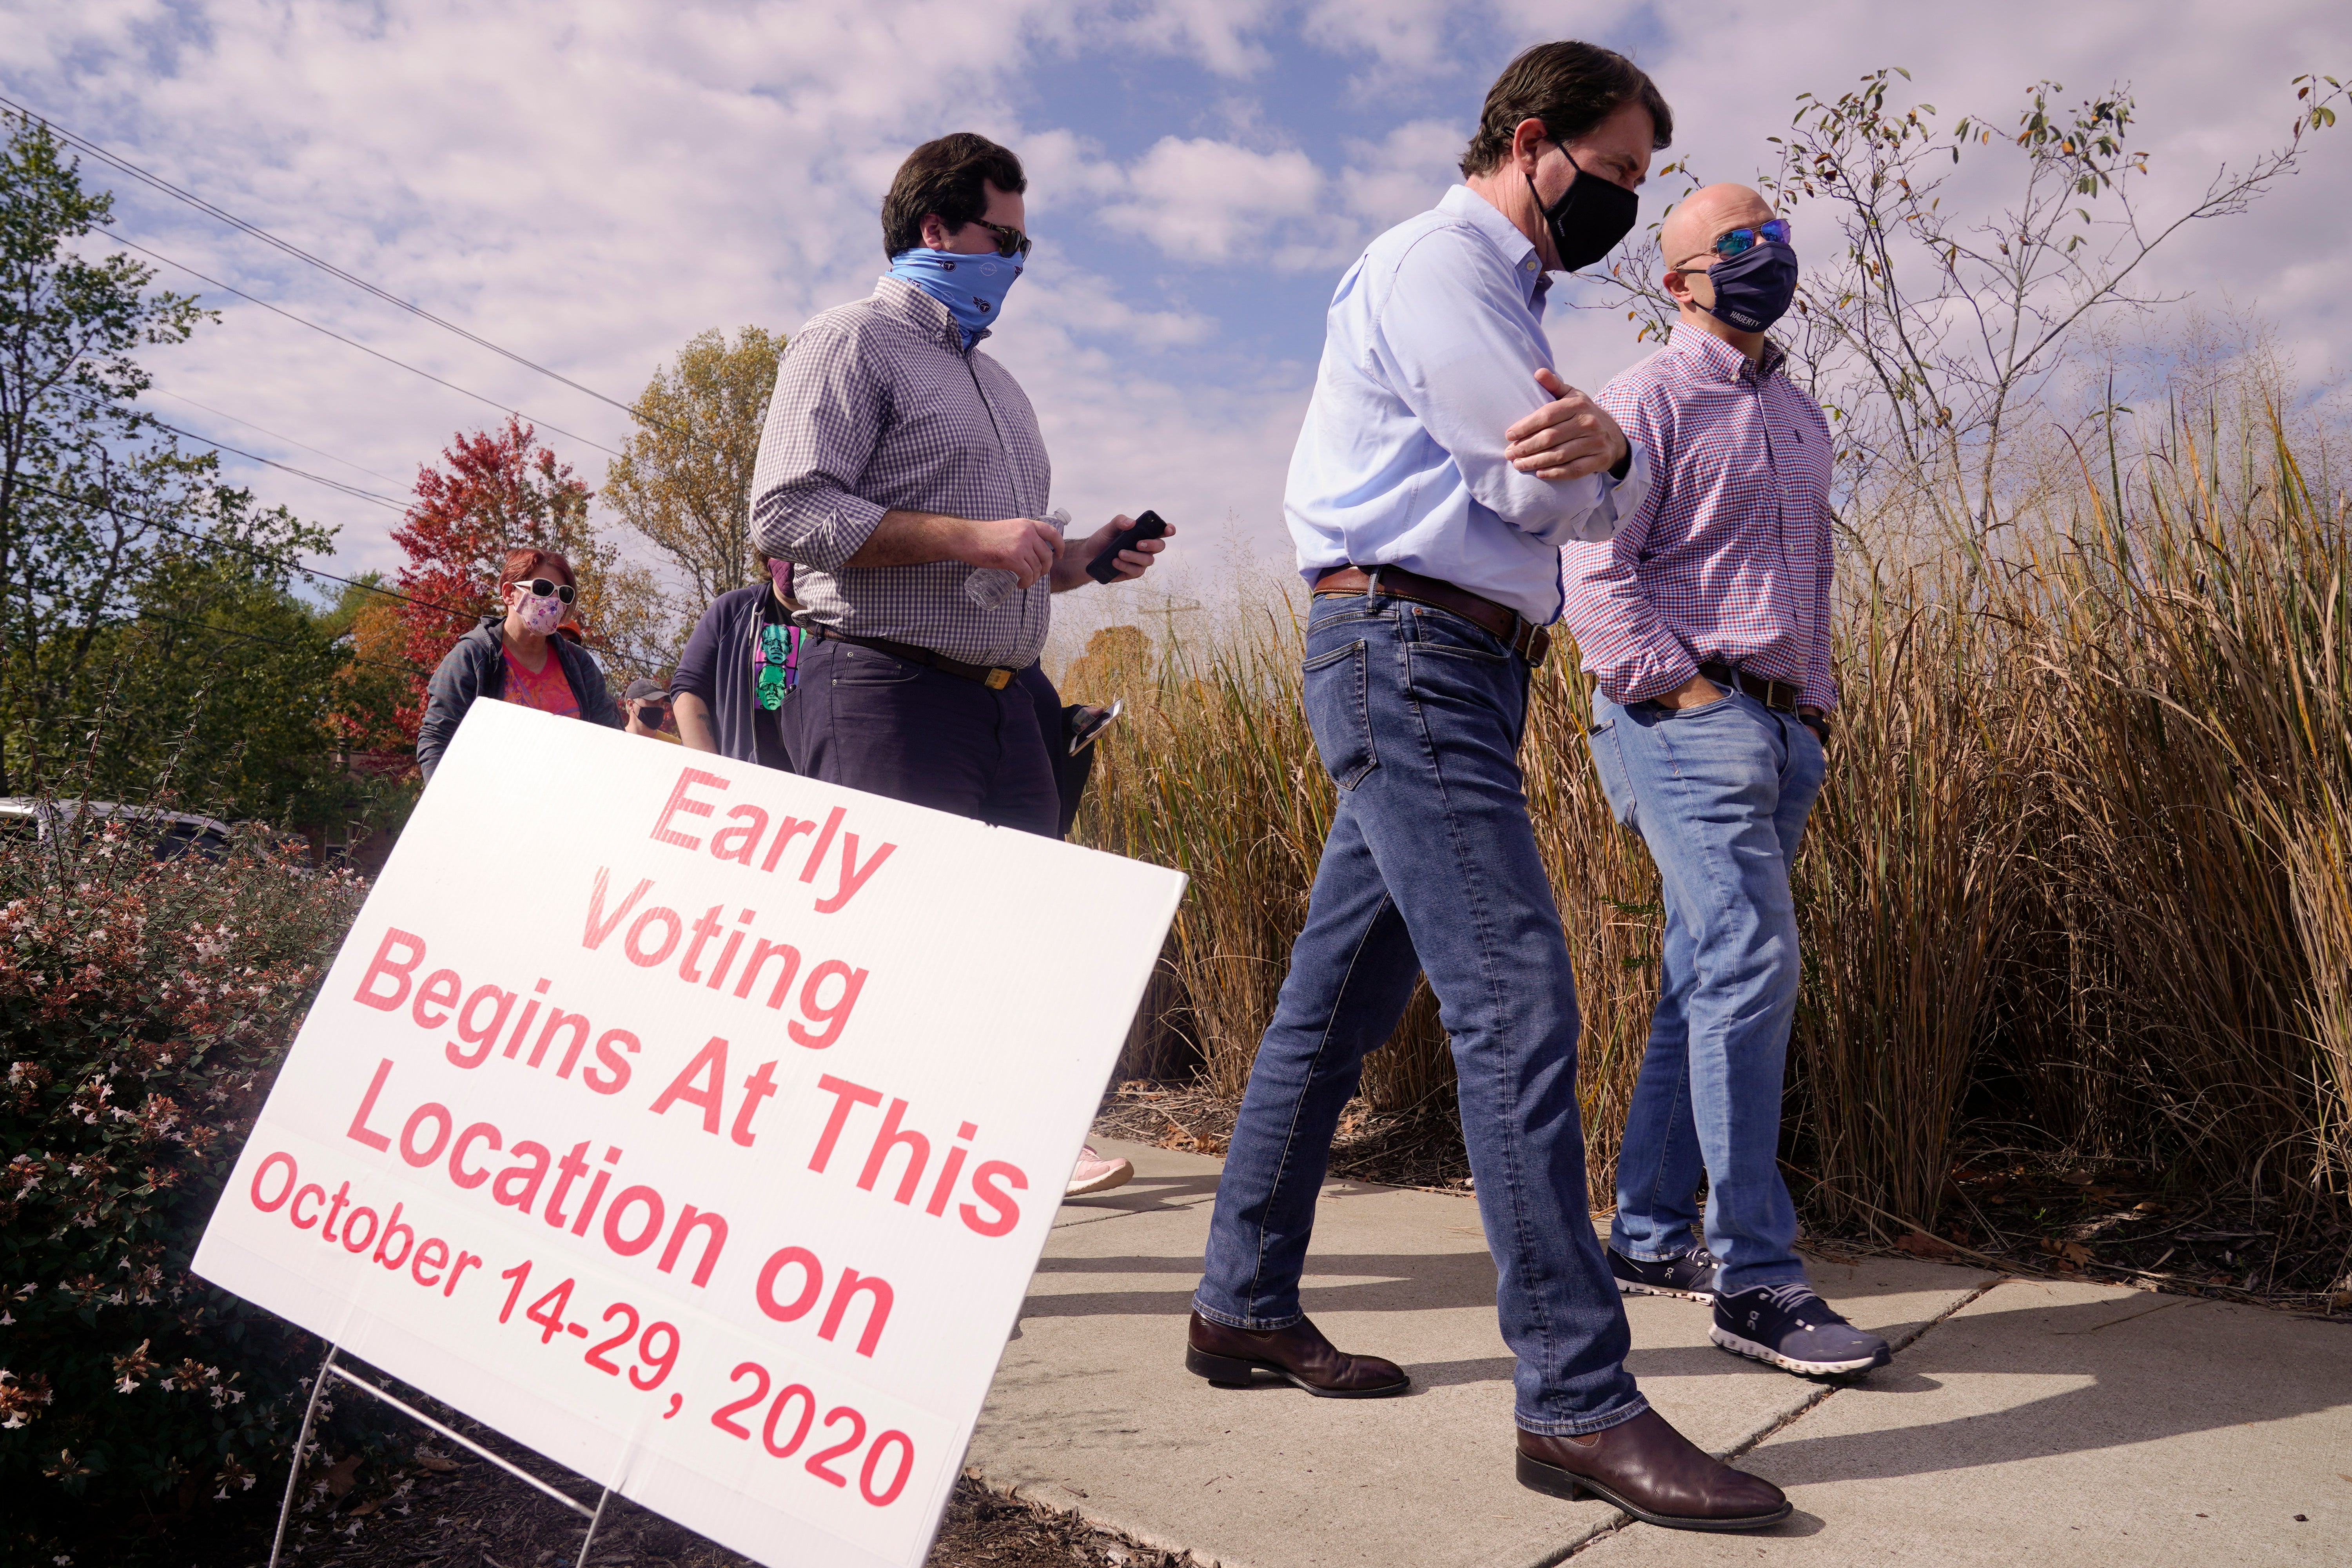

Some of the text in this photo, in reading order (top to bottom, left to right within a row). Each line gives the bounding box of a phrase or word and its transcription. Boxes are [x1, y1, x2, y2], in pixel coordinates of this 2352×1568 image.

[1730, 310, 1761, 327] HAGERTY
[582, 865, 869, 1050] Voting
[649, 766, 898, 914] Early
[352, 926, 1029, 1238] Begins At This
[249, 1151, 915, 1508] October 14-29, 2020
[345, 1058, 895, 1359] Location on
